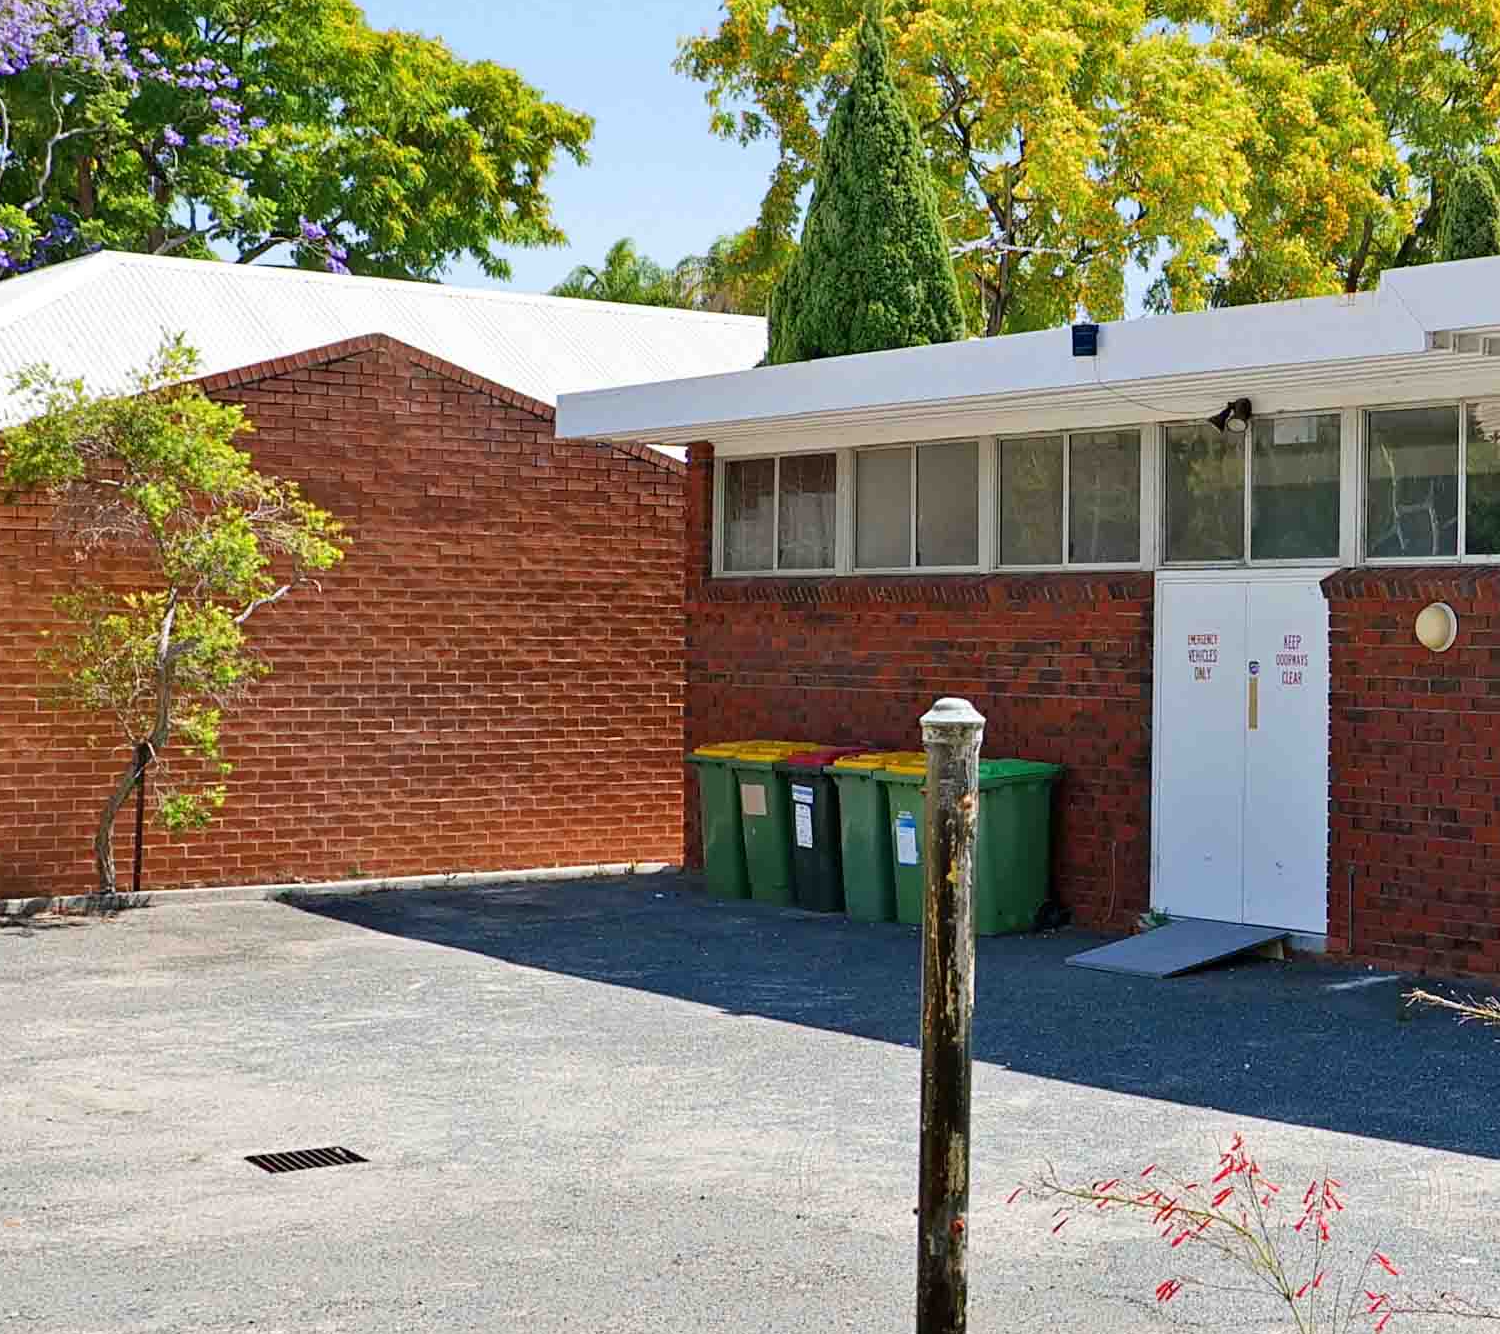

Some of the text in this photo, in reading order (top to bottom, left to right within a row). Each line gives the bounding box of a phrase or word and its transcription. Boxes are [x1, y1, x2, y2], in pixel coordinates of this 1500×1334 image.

[1187, 634, 1220, 645] EMERGENCY
[1283, 634, 1302, 649] KEEP
[1187, 649, 1218, 663] VEHICLES
[1275, 653, 1309, 666] DOORWAYS
[1194, 666, 1212, 681] ONLY
[1282, 670, 1302, 685] CLEAR
